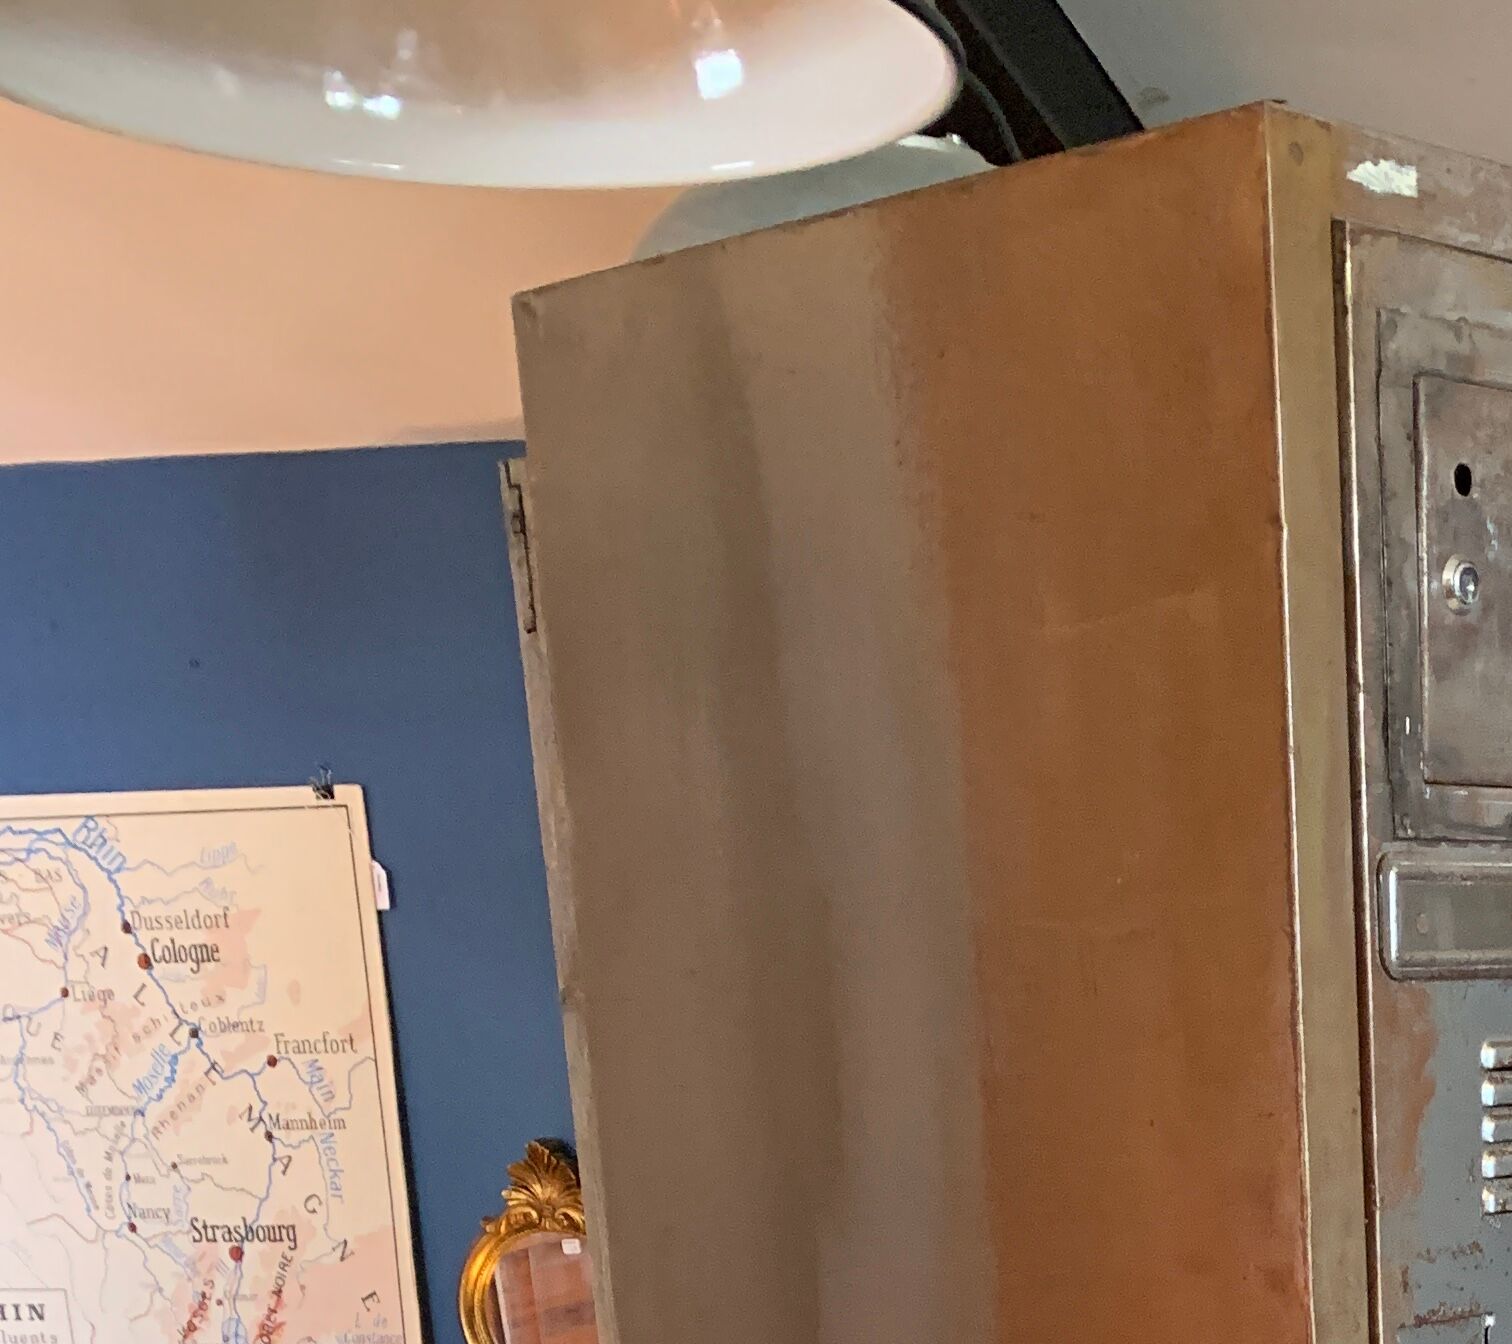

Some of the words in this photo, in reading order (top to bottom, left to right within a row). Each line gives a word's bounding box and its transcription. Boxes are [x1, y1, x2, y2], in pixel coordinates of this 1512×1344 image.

[73, 816, 127, 876] Rhin
[130, 905, 230, 934] Dusseldorf
[150, 936, 221, 974] Cologne
[274, 1031, 358, 1055] Francfort
[132, 1042, 172, 1099] Moselle
[302, 1057, 336, 1103] Main
[268, 1111, 348, 1131] Mannheim
[318, 1131, 345, 1206] Neckar
[127, 1202, 171, 1225] Nancy
[190, 1216, 298, 1251] Strasbourg
